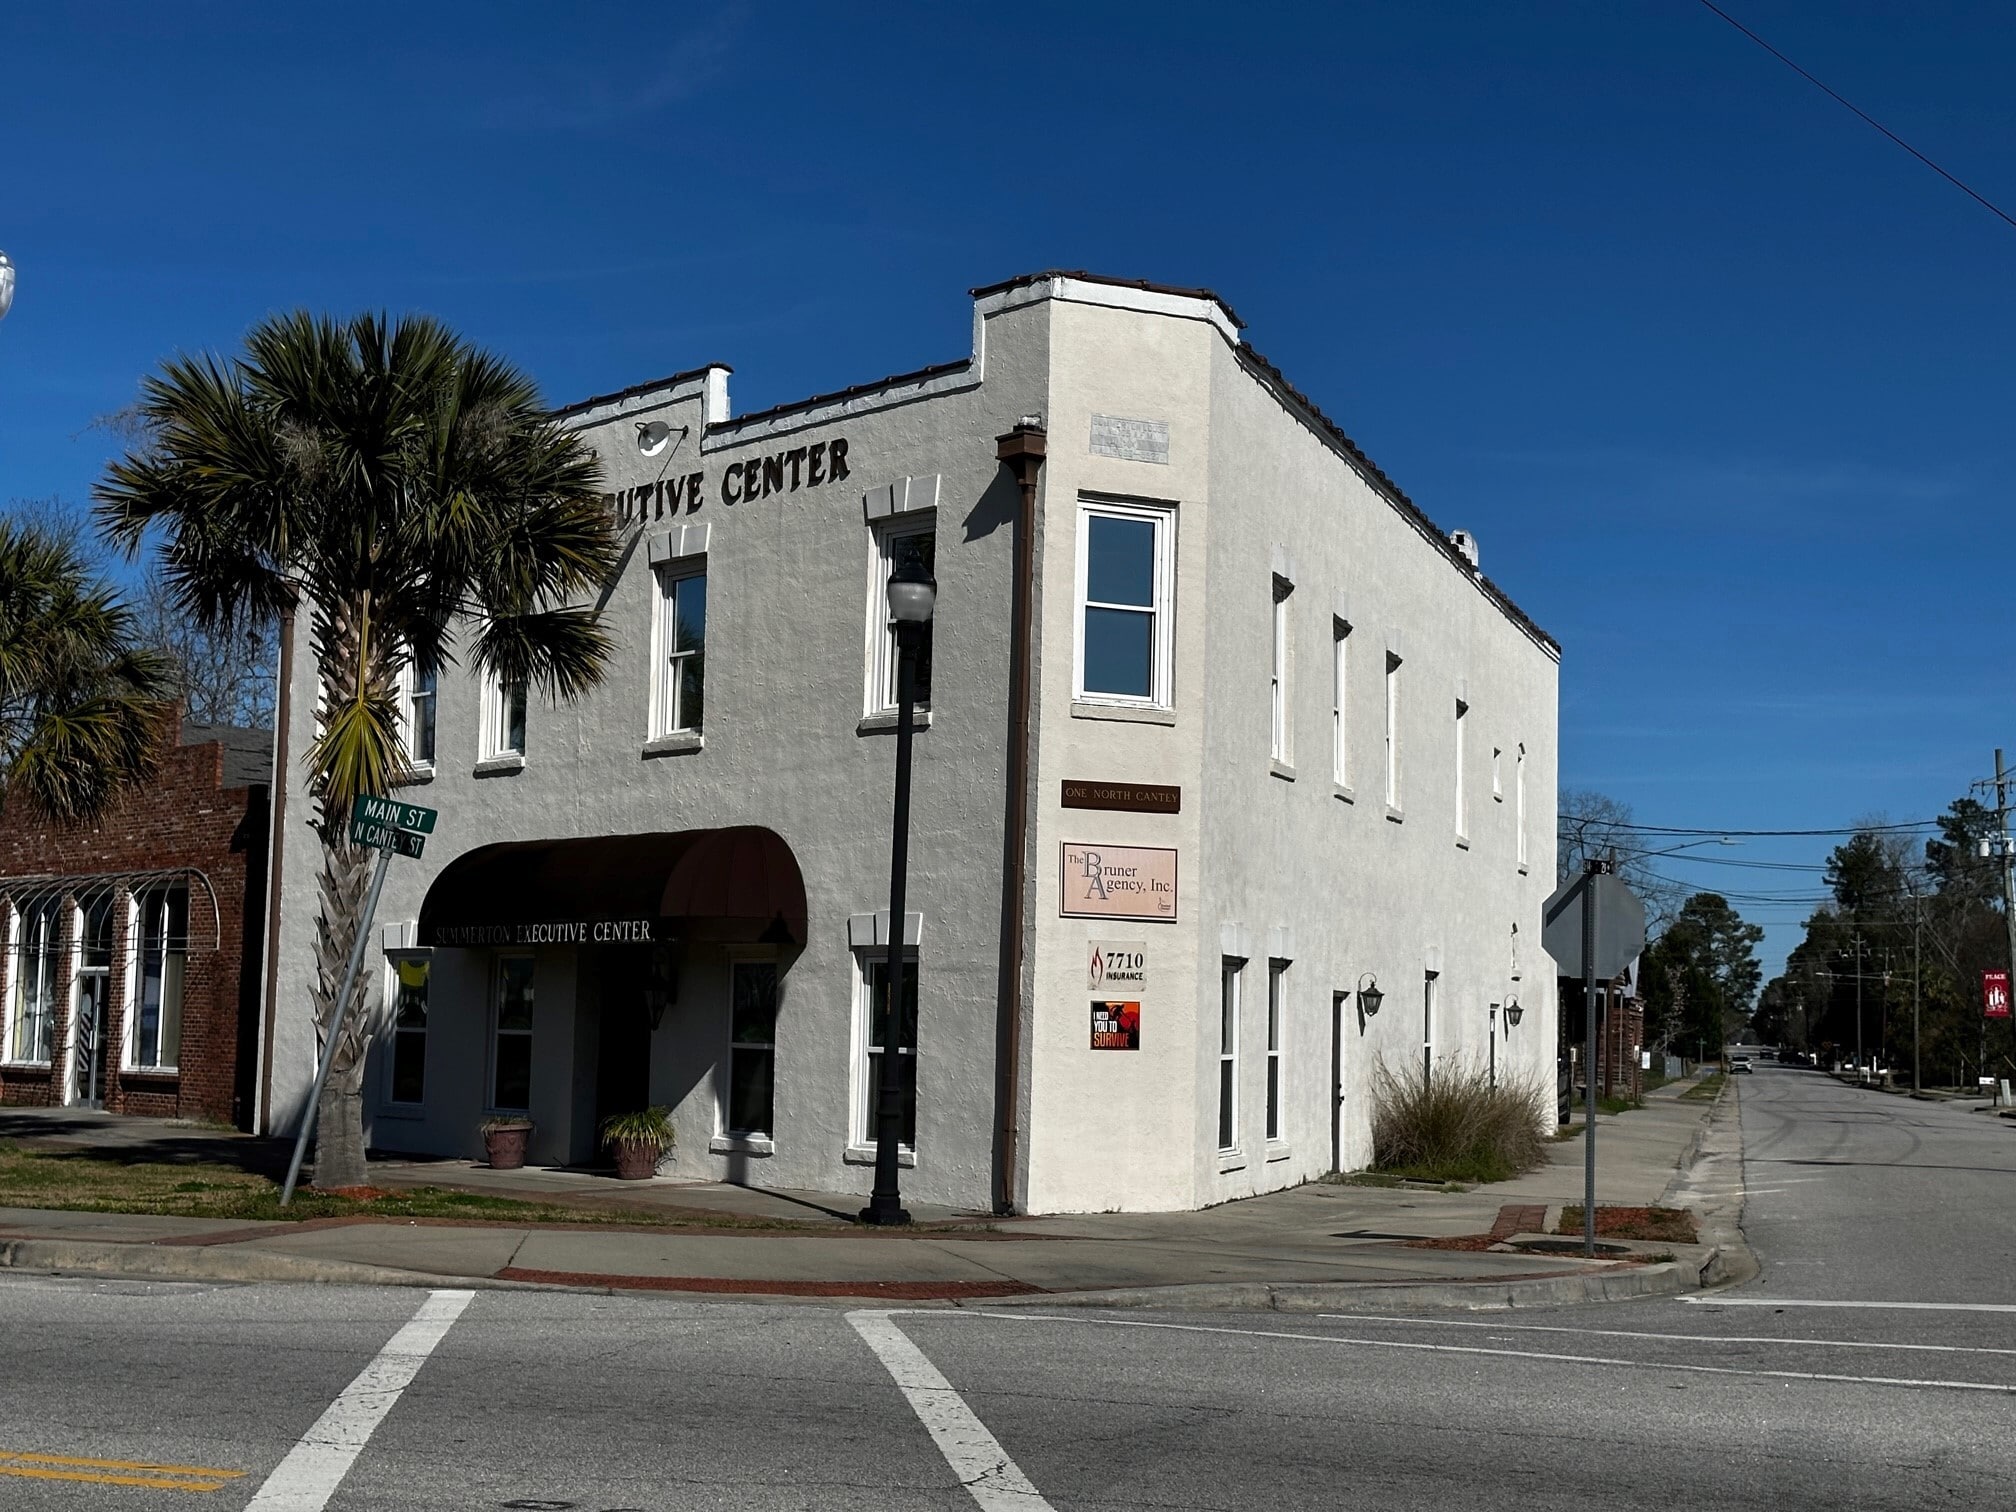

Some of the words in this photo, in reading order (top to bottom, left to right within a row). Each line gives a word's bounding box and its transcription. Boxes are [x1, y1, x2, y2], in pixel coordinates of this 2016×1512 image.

[721, 438, 851, 506] CENTER
[1065, 787, 1087, 798] ONE
[1093, 789, 1131, 801] NORTH
[1136, 792, 1178, 803] CANTEY
[364, 800, 402, 823] MAIN
[406, 809, 427, 828] ST
[354, 822, 365, 840] N
[366, 825, 406, 850] CANTEY
[408, 836, 423, 855] ST
[1068, 854, 1084, 864] The
[1081, 851, 1138, 878] Bruner
[1084, 874, 1147, 900] Agency,
[1151, 878, 1174, 893] Inc.
[516, 922, 588, 943] EXECUTIVE
[1106, 952, 1144, 969] 7710
[1105, 972, 1144, 981] INSURANCE
[1094, 1021, 1108, 1033] YOU
[1108, 1021, 1118, 1033] TO
[1093, 1032, 1130, 1048] SURVIVE
